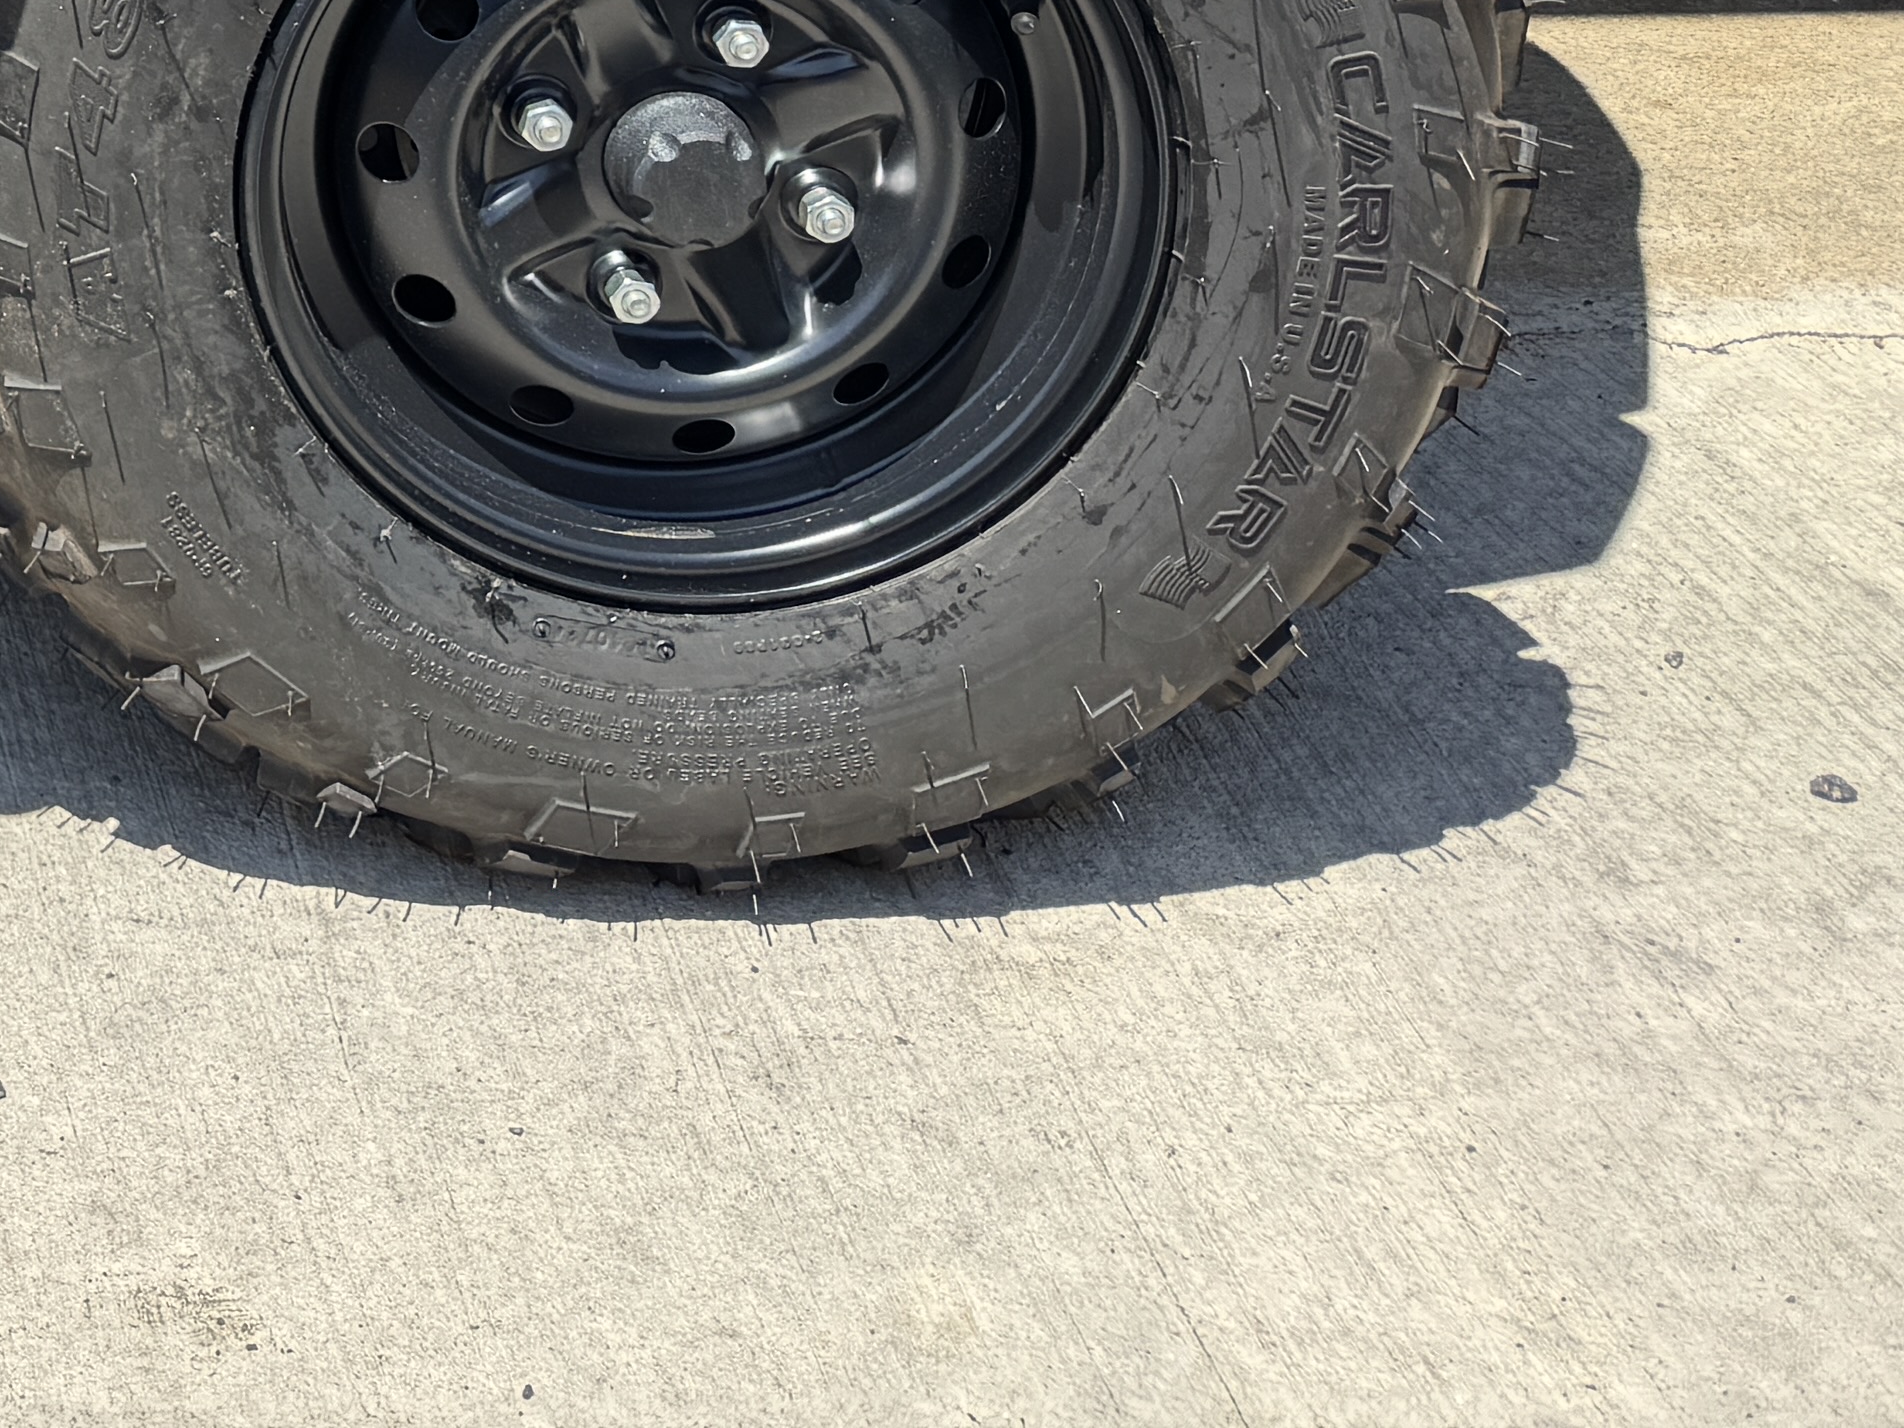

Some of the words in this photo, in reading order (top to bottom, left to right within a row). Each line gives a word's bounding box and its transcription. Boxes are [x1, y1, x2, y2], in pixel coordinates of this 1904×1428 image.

[1296, 185, 1328, 279] MADE
[1206, 50, 1394, 554] CARLSTAR
[1288, 283, 1318, 316] IN
[160, 488, 247, 584] TUBELESS
[436, 715, 519, 755] MANUAL
